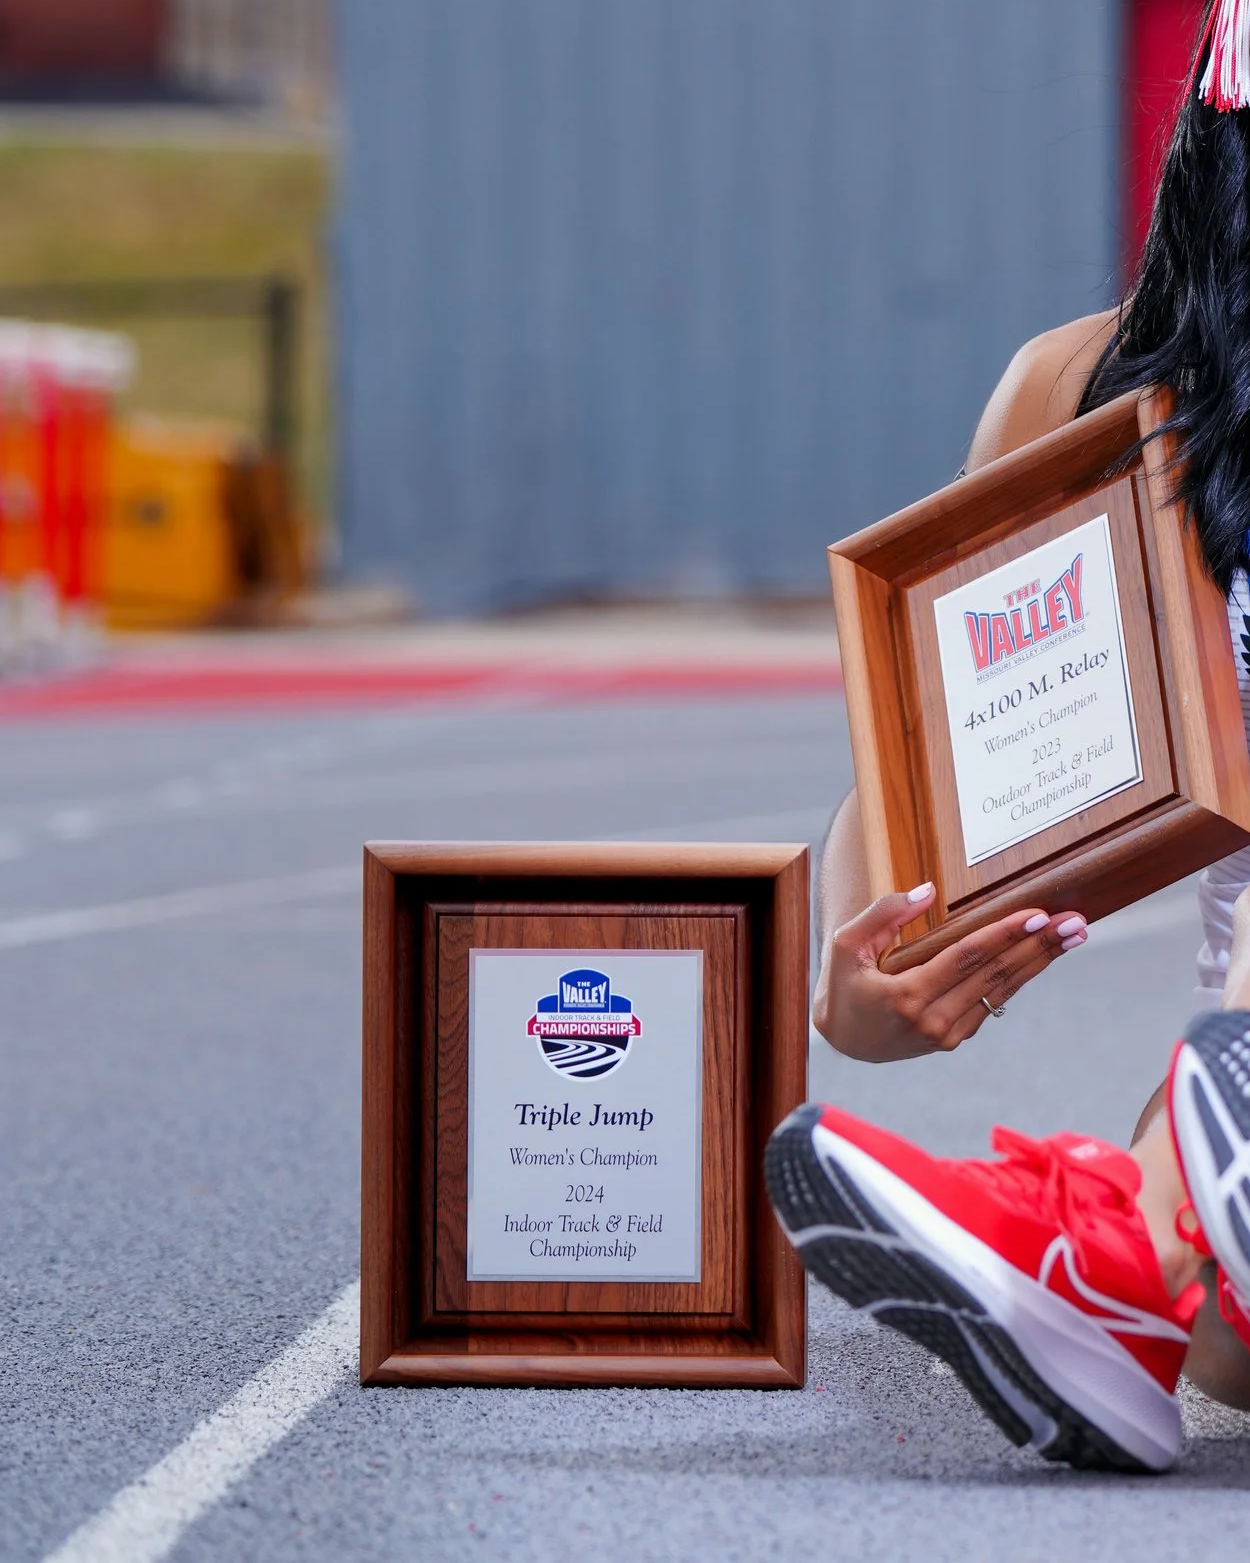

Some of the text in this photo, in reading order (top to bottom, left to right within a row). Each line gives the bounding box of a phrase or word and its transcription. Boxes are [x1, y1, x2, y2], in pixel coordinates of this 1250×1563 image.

[1003, 578, 1041, 608] THE
[964, 552, 1084, 673] VALLEY
[977, 624, 1086, 683] MISSOURI VALLEY CONFERENCE
[964, 649, 1110, 731] 4x100 M. Relay
[984, 691, 1098, 755] Women's Champion
[1032, 737, 1062, 765] 2023
[982, 735, 1114, 814] Outdoor Track & Field
[1011, 772, 1092, 821] Championship
[562, 981, 607, 1003] VALLEY
[533, 1023, 636, 1035] CHAMPIONSHIPS
[514, 1103, 654, 1131] Triple Jump
[509, 1147, 658, 1170] Women's Champion
[565, 1184, 604, 1204] 2024
[504, 1214, 663, 1233] Indoor Track & Field
[529, 1239, 637, 1261] Championship
